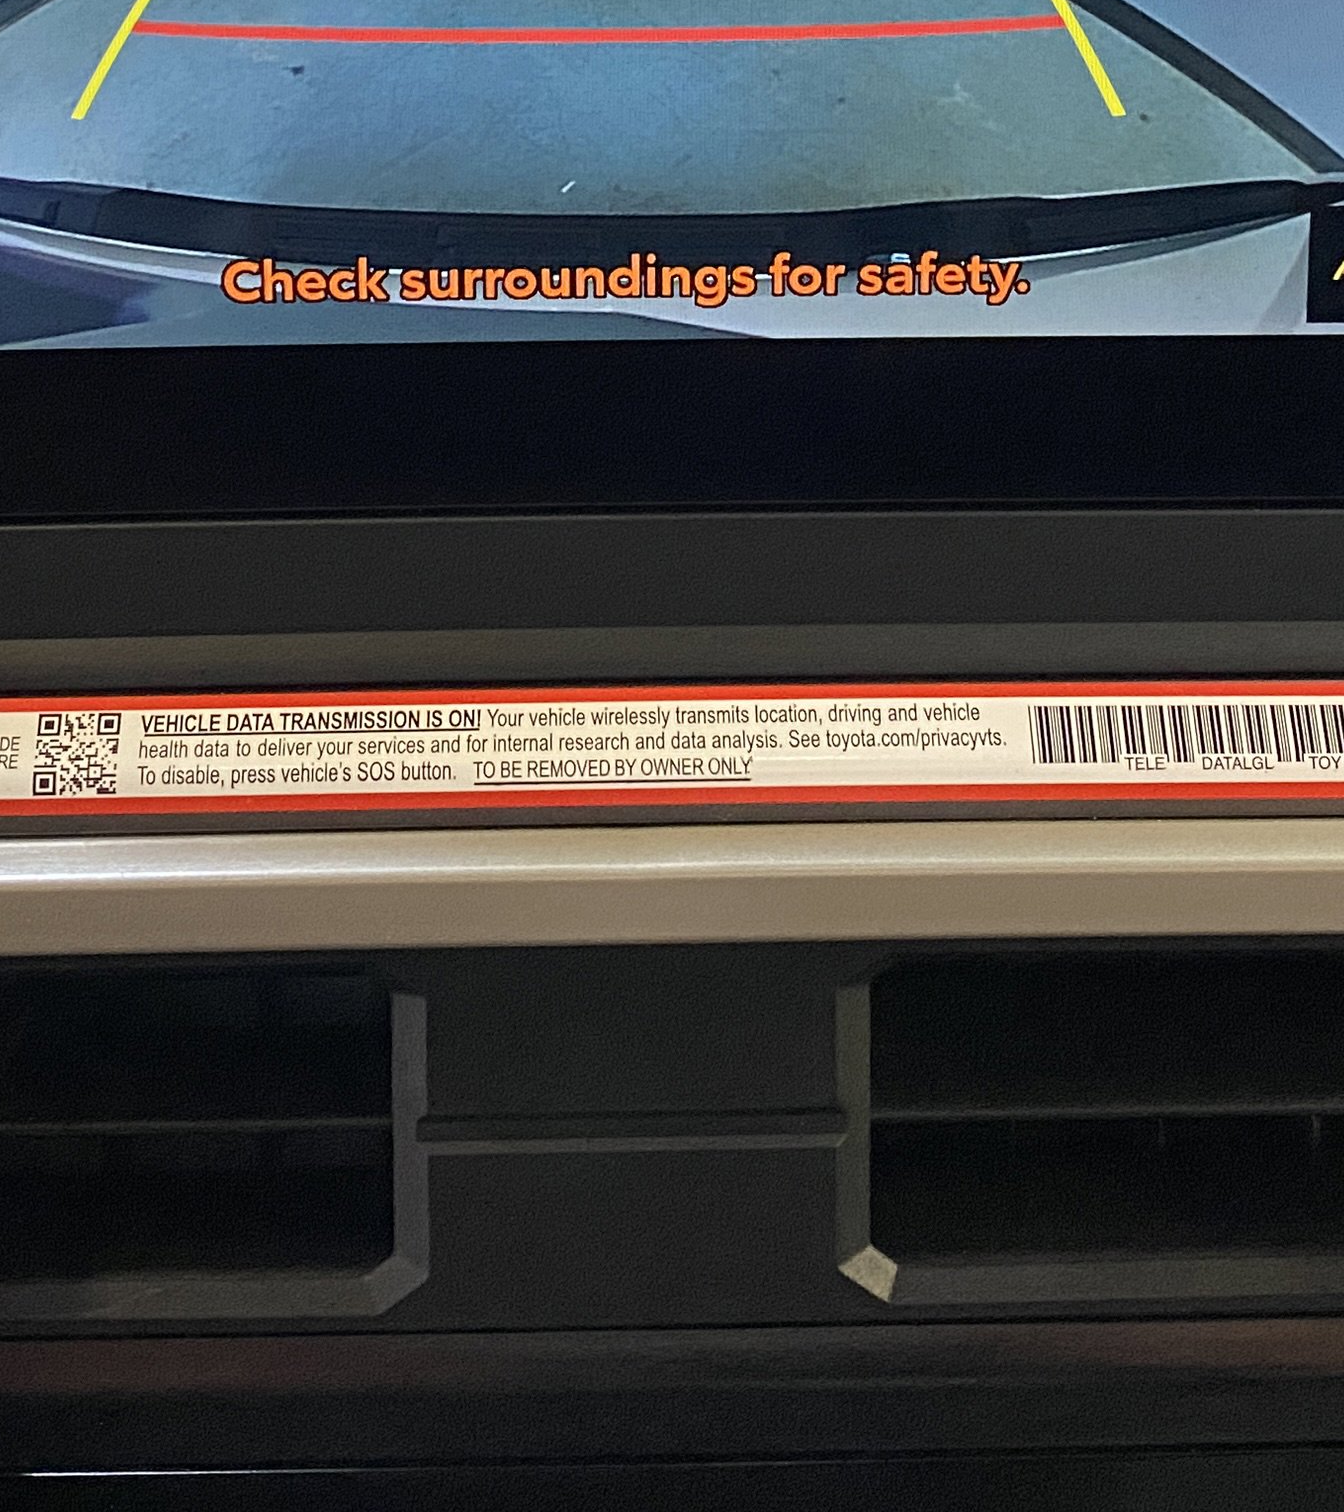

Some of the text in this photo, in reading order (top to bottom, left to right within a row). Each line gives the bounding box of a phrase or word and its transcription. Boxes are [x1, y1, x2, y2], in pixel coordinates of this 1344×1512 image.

[221, 249, 1031, 308] Check surroundings for safety.
[142, 702, 981, 733] VEHICLE DATA TRANSMISSION IS ON! Your vehicle wirelessly transmits location, driving and vehicle
[138, 728, 1008, 760] health data to deliver your services and for internal research and data analysis. See toyota.com/privacyvts.
[138, 765, 157, 785] To
[161, 764, 225, 787] disable,
[230, 767, 276, 789] press
[281, 761, 352, 783] vehicle's
[357, 761, 396, 782] SOS
[401, 760, 457, 781] button.
[473, 761, 496, 779] TO
[501, 760, 523, 778] BE
[527, 759, 610, 778] REMOVED
[615, 758, 637, 777] BY
[640, 757, 704, 776] OWNER
[1124, 755, 1342, 771] TELE DATALGL TOY
